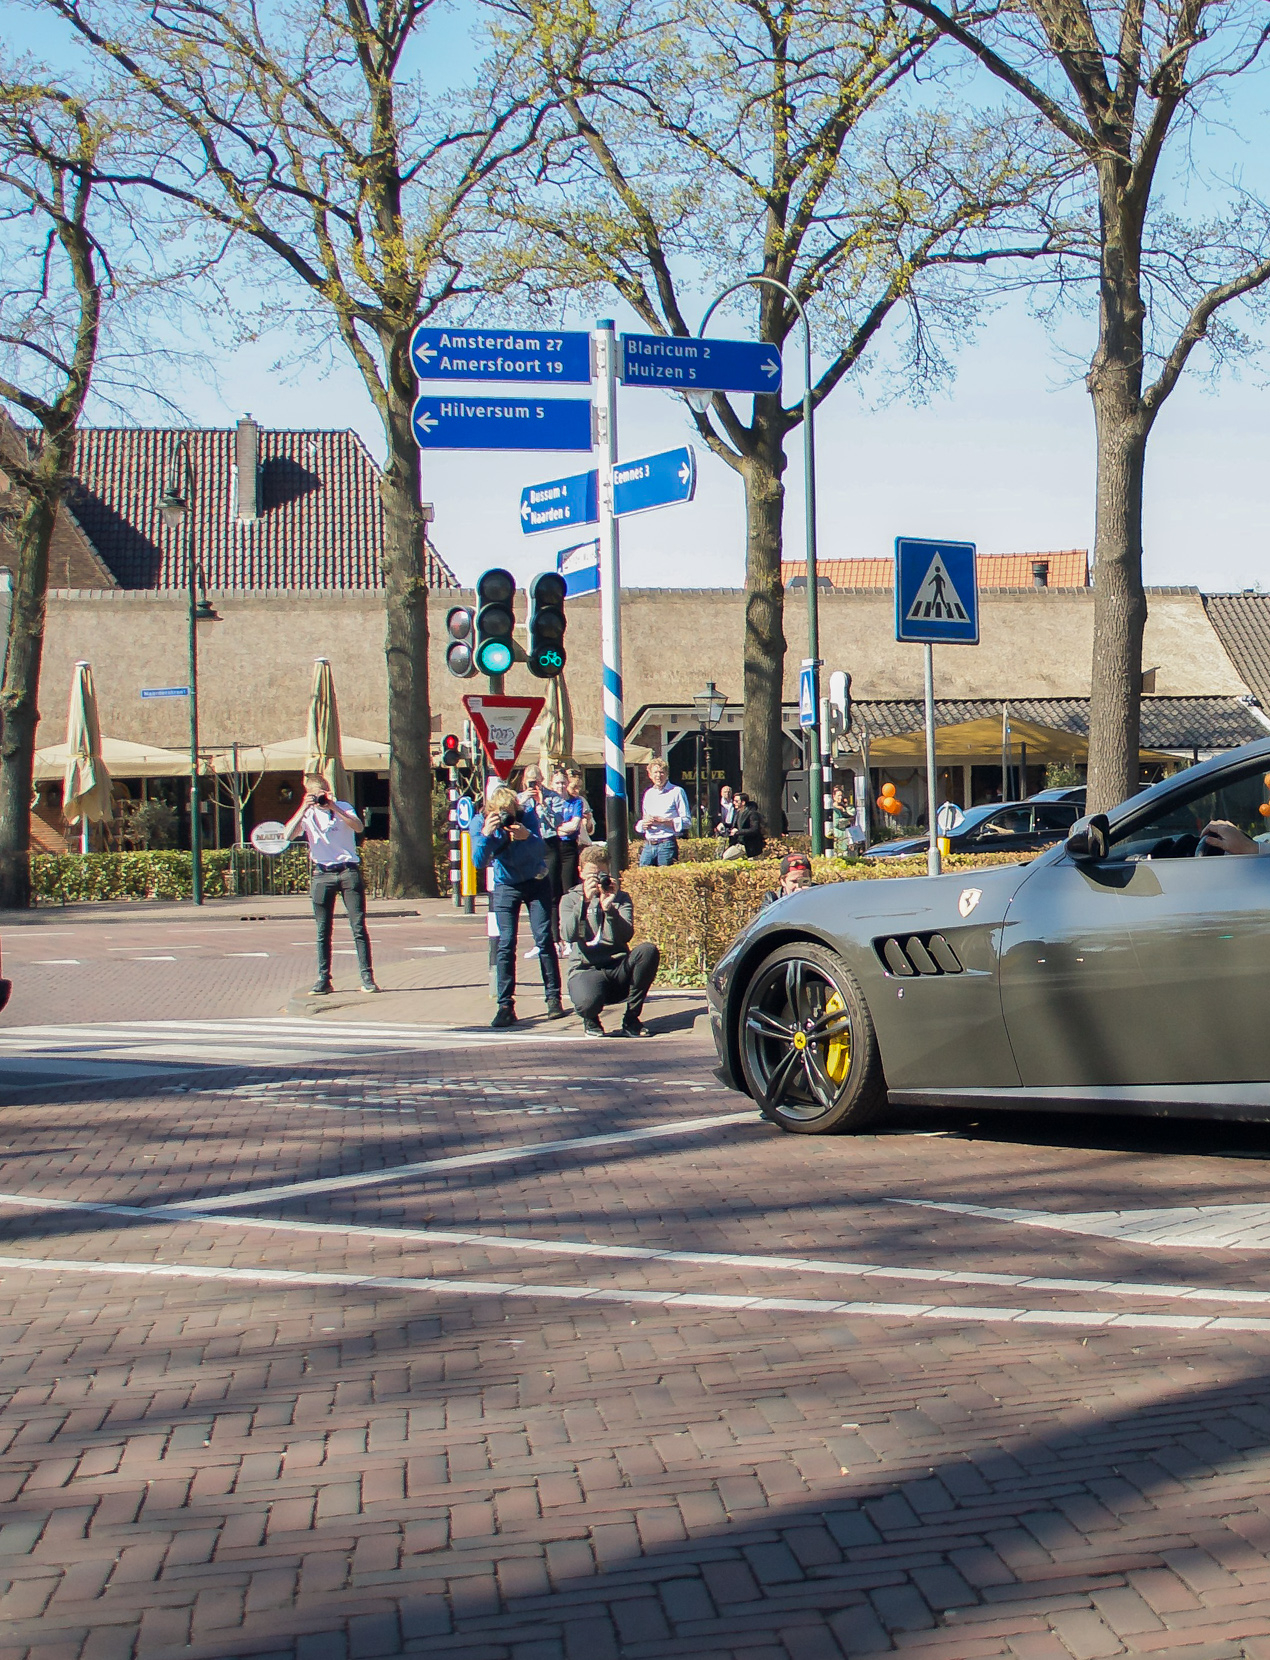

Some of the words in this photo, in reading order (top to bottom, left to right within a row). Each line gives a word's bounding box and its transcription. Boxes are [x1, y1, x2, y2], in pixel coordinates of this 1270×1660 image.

[439, 333, 541, 351] Amsterdam
[546, 339, 563, 352] 27
[628, 340, 698, 358] Blaricum
[703, 347, 711, 359] 2
[439, 356, 542, 373] Amersfoort
[546, 361, 564, 373] 19
[628, 362, 683, 379] Huizen
[688, 368, 697, 379] 5
[439, 402, 530, 419] Hilversum
[535, 407, 545, 419] 5
[613, 467, 644, 485] Eemnes
[644, 465, 650, 478] 3
[530, 487, 561, 505] Bussum
[561, 485, 567, 497] 4
[530, 508, 563, 525] Naarden
[565, 506, 571, 518] 6
